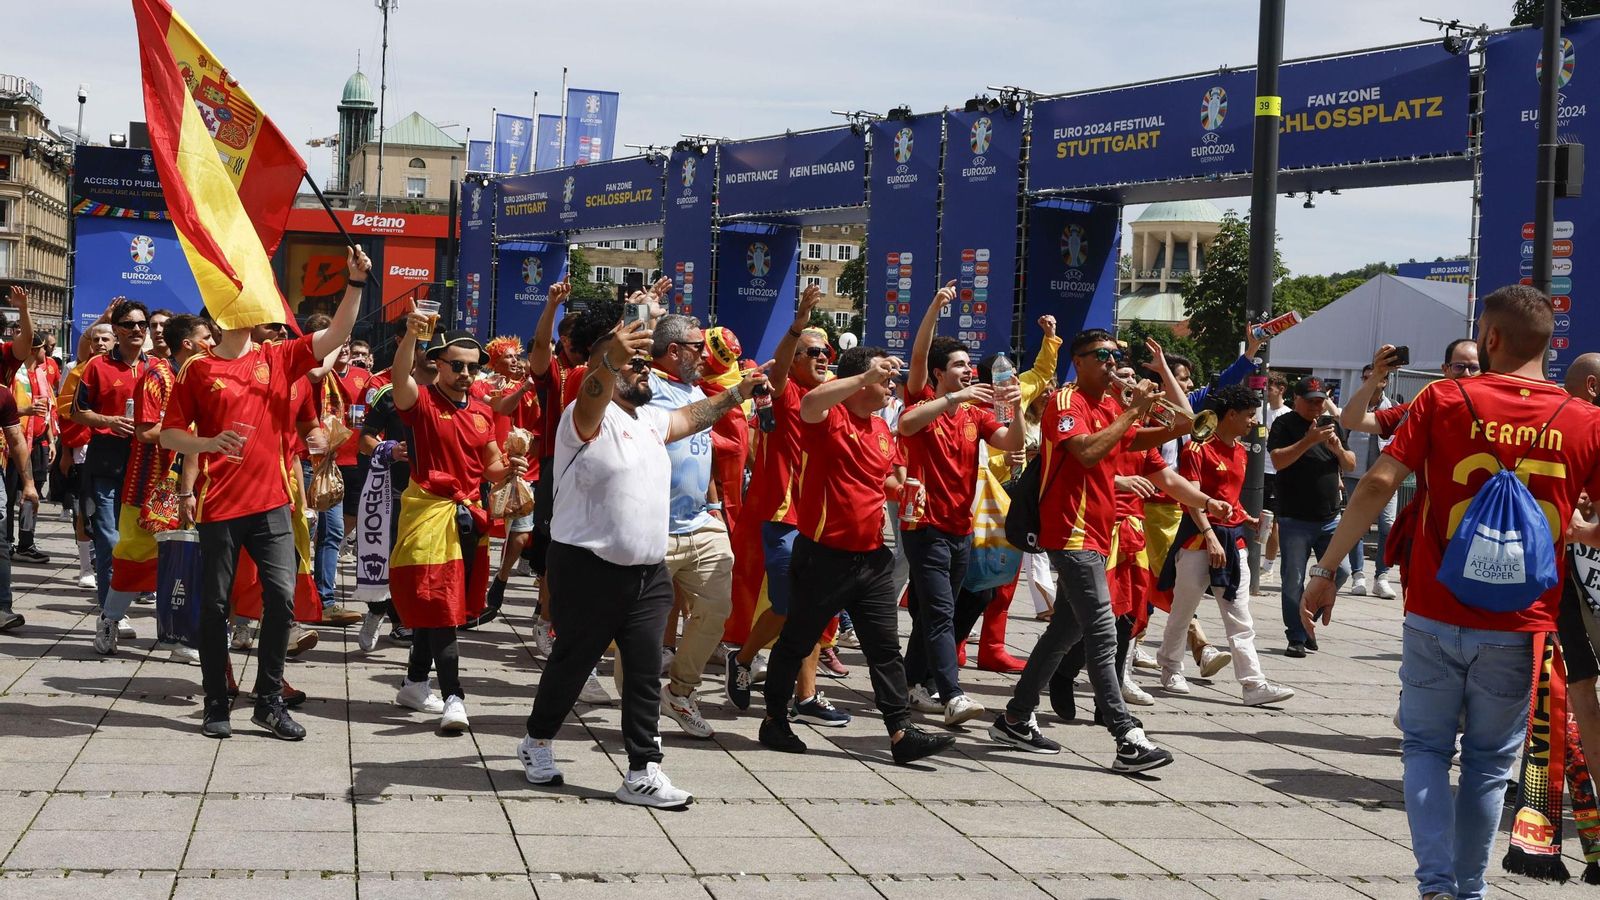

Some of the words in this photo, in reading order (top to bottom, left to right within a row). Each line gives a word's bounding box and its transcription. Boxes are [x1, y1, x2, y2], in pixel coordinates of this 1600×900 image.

[1307, 93, 1336, 107] FAN
[1339, 87, 1380, 104] ZONE
[1259, 101, 1270, 110] 39
[1278, 96, 1443, 135] HLOSSPLATZ
[1053, 126, 1082, 140] EURO
[1084, 122, 1112, 136] 2024
[1113, 115, 1165, 132] FESTIVAL
[1056, 130, 1161, 159] STUTTGART
[1191, 143, 1235, 157] EURO2024
[725, 174, 736, 184] NO
[737, 169, 778, 183] ENTRANCE
[789, 165, 810, 178] KEIN
[811, 160, 855, 175] EINGANG
[962, 166, 996, 177] EURO2024
[83, 177, 119, 185] ACCESS
[887, 174, 918, 184] EURO2024
[605, 183, 616, 192] FAN
[616, 181, 632, 191] ZONE
[503, 196, 515, 204] EURO
[515, 194, 527, 203] 2024
[527, 192, 548, 200] FESTIVAL
[585, 188, 652, 208] SCHLOSSPLATZ
[676, 196, 698, 205] EURO2024
[505, 201, 547, 216] STUTTGART
[352, 213, 405, 228] Betano
[121, 272, 162, 280] EURO2024
[389, 266, 429, 277] Betano
[738, 287, 778, 297] EURO2024
[1050, 280, 1095, 292] EURO2024
[690, 432, 709, 455] 69
[1470, 560, 1521, 572] ATLANTIC
[1474, 569, 1514, 580] COPPER
[681, 713, 706, 730] ESPAÑA
[1513, 819, 1557, 842] MRF
